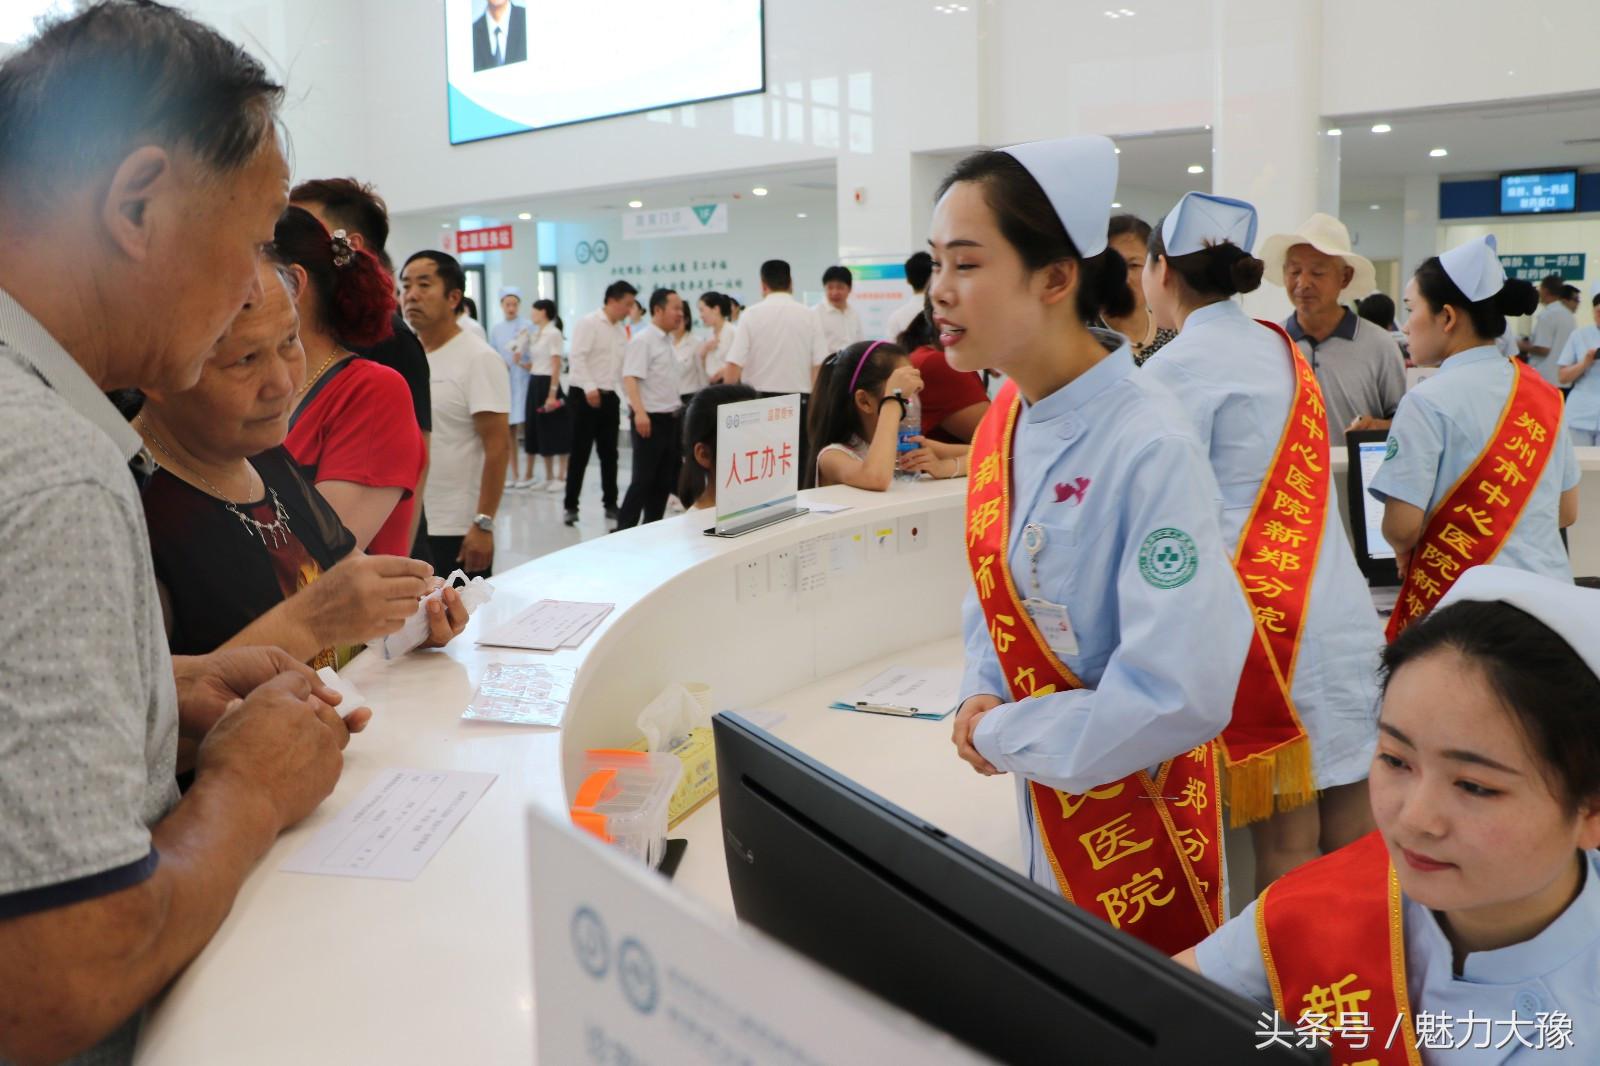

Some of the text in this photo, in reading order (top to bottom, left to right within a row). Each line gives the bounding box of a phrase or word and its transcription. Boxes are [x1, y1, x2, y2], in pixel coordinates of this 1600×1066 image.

[725, 442, 792, 488] 人工办卡
[1399, 411, 1547, 633] 郑州市中心医院新郑
